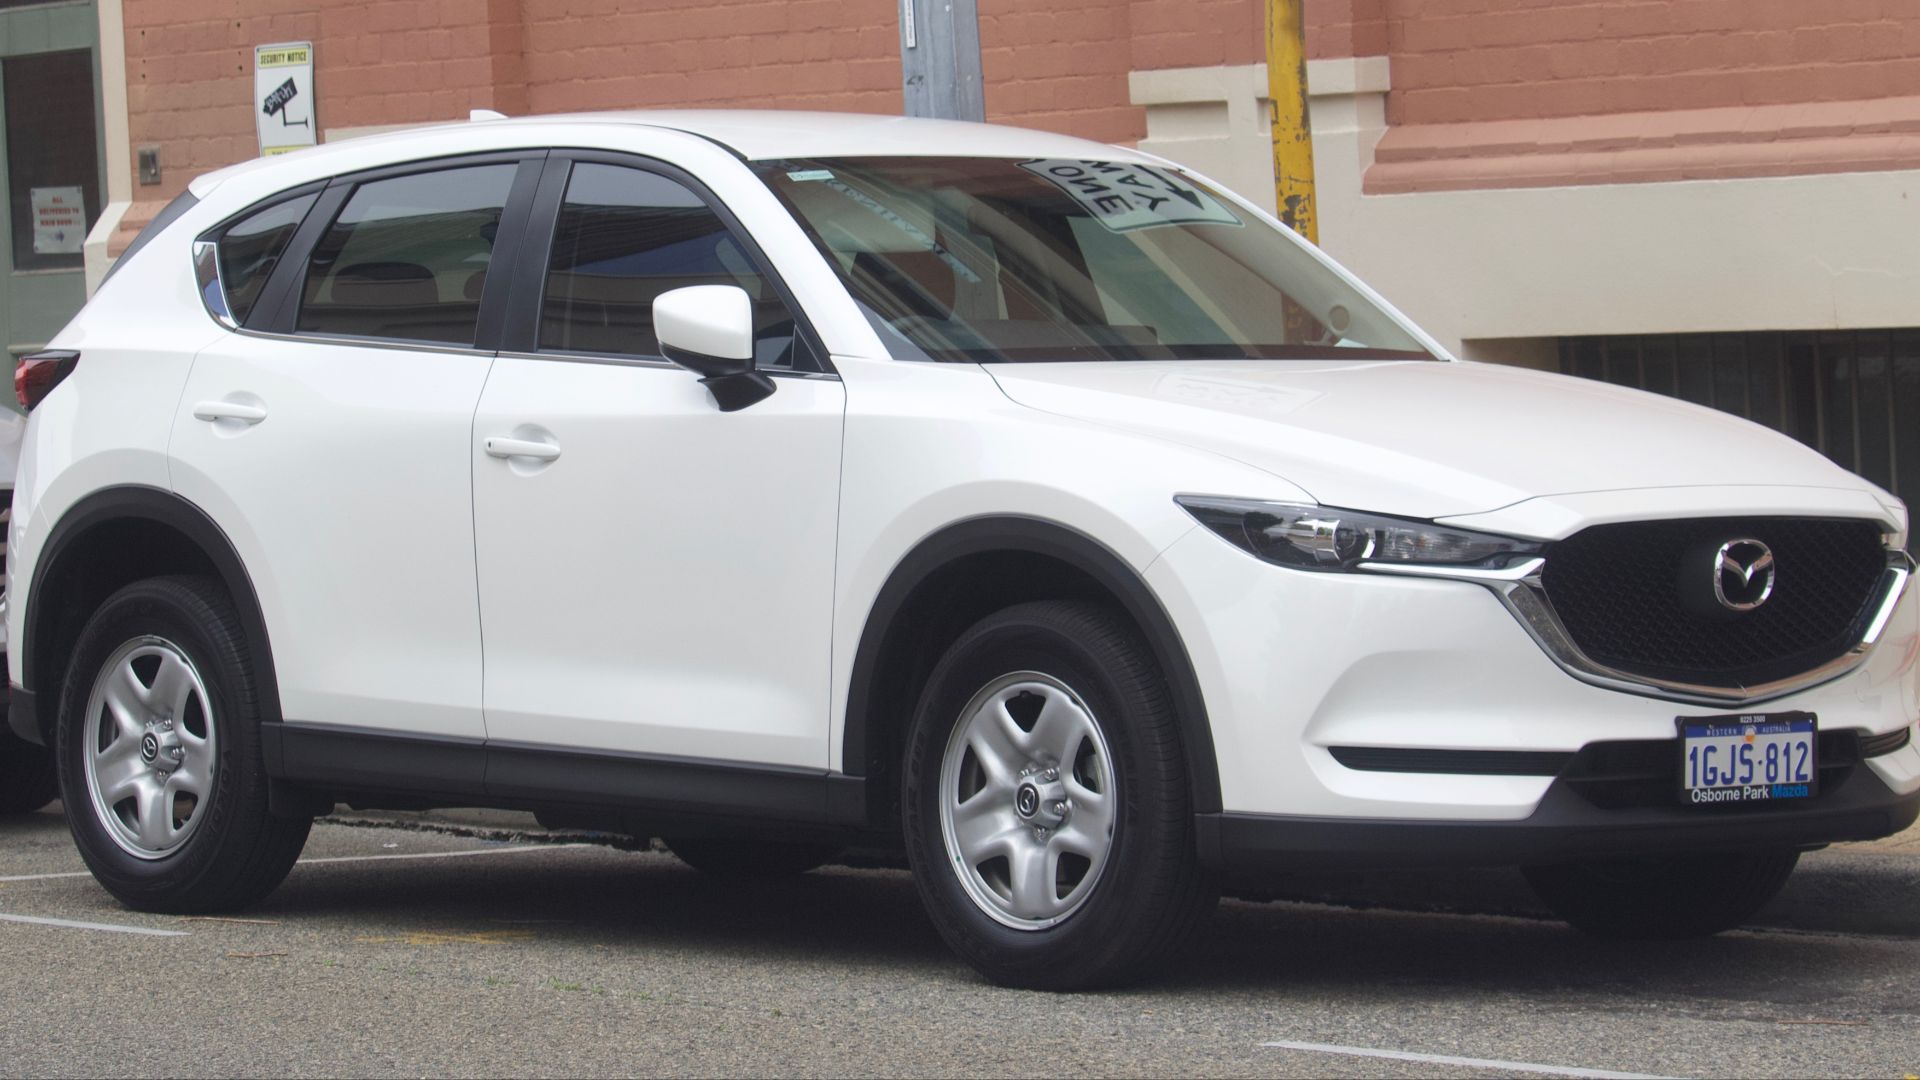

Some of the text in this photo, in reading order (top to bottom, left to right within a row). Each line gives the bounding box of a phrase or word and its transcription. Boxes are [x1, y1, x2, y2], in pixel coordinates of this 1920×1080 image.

[261, 51, 307, 65] SECURITY NOTICE
[1706, 725, 1791, 737] WESTERN AUSTRALIA
[1691, 784, 1808, 803] Osborne Park Mazda
